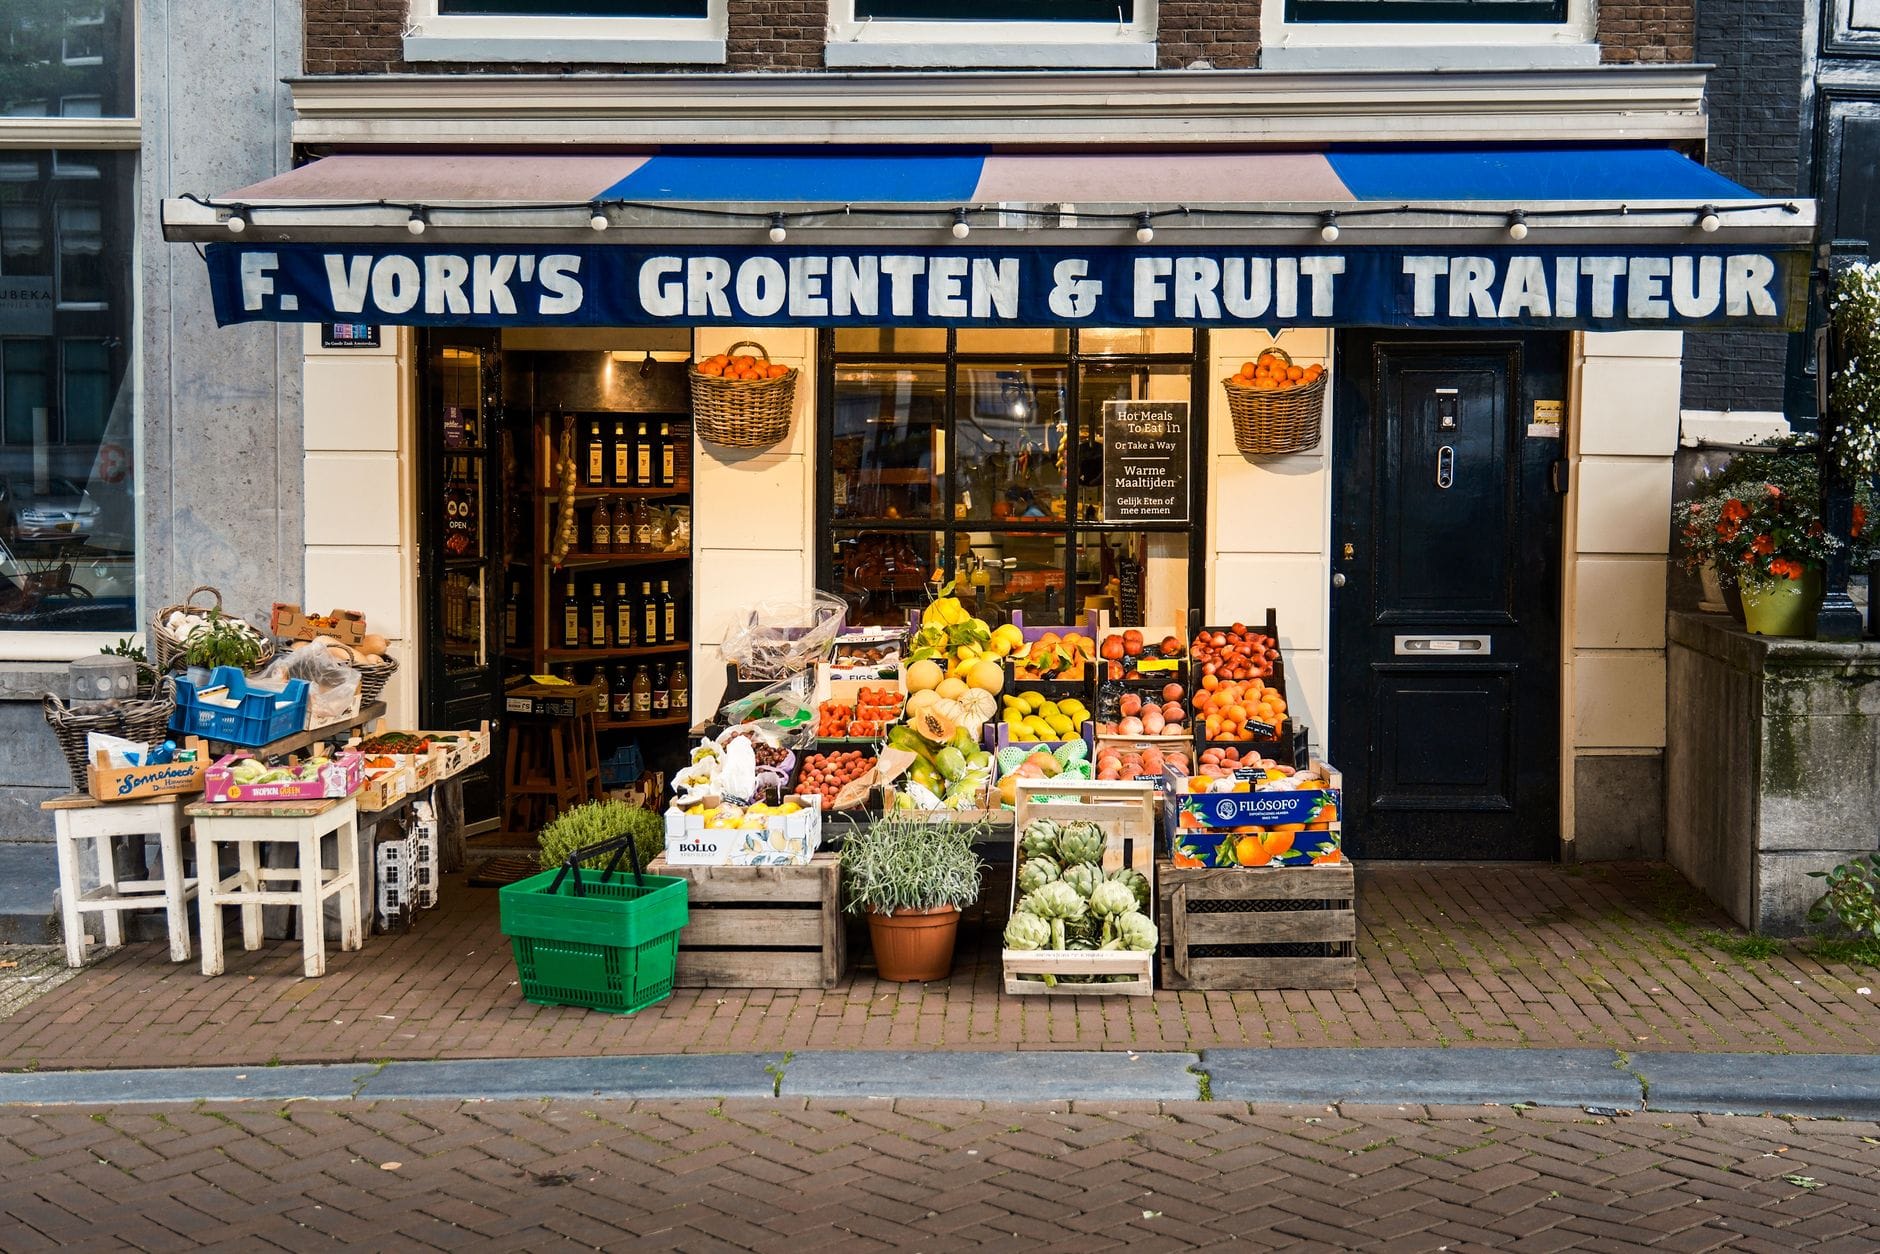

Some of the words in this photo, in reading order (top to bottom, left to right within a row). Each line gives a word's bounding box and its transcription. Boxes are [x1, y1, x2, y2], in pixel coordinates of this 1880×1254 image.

[240, 251, 299, 312] F.
[324, 253, 584, 315] VORK'S
[638, 255, 1019, 318] GROENTEN
[1049, 257, 1103, 318] &
[1133, 255, 1346, 318] FRUIT
[1403, 254, 1778, 318] TRAITEUR
[1117, 411, 1139, 421] Hot
[1141, 411, 1173, 421] Meals
[1128, 423, 1142, 433] To
[1144, 423, 1162, 433] Eat
[1167, 421, 1181, 433] in
[1115, 442, 1127, 450] Or
[1128, 441, 1148, 450] Take
[1156, 441, 1176, 451] Way
[1124, 465, 1166, 475] Warme
[1115, 477, 1175, 490] Maaltijden
[1117, 497, 1142, 507] Gelijk
[1143, 497, 1163, 506] Eten
[1164, 497, 1175, 506] of
[1120, 507, 1139, 515] mee
[1140, 507, 1171, 515] nemen
[449, 521, 467, 529] OPEN
[279, 786, 301, 794] QUEEN
[1239, 799, 1298, 811] FILÓSOFO
[679, 843, 717, 852] BOLLO
